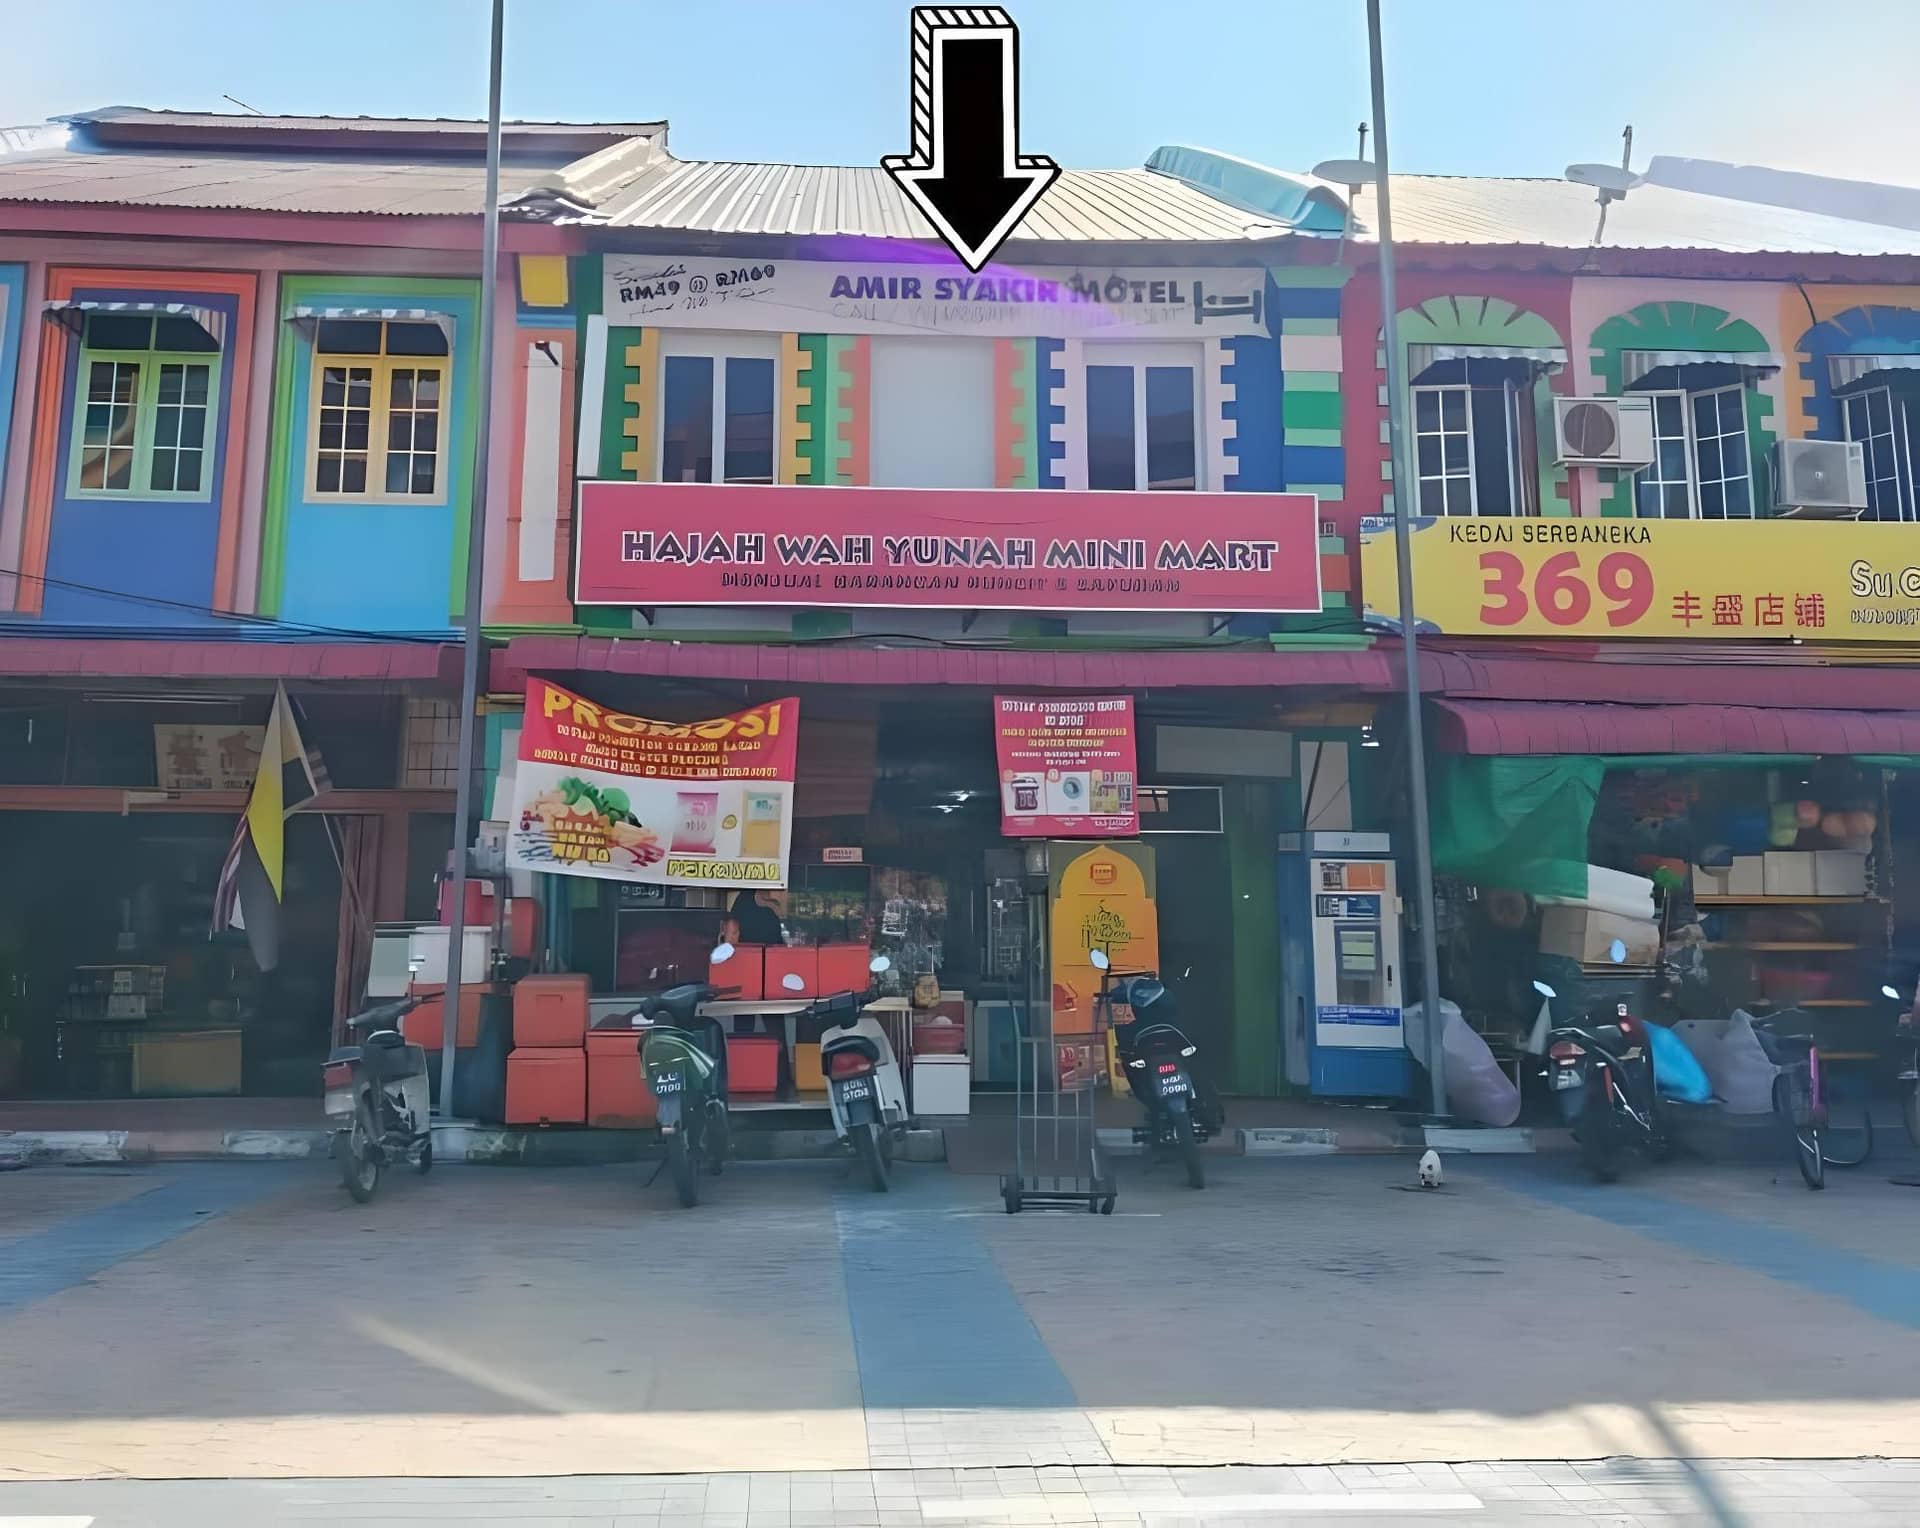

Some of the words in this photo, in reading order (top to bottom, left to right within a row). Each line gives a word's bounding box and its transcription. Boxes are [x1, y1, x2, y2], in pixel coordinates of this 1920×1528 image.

[830, 275, 922, 300] AMIR
[934, 277, 1057, 304] SYAKIR
[1067, 271, 1186, 304] MOTEL
[621, 530, 766, 566] HAJAH
[773, 533, 873, 566] WAH
[883, 535, 1035, 569] YUNAH
[1044, 537, 1146, 570] MINI
[1155, 539, 1279, 572] MART
[1450, 524, 1513, 543] KEDAI
[1522, 524, 1652, 543] SERBANEKA
[1479, 551, 1655, 628] 369
[543, 685, 781, 740] PROMOSI
